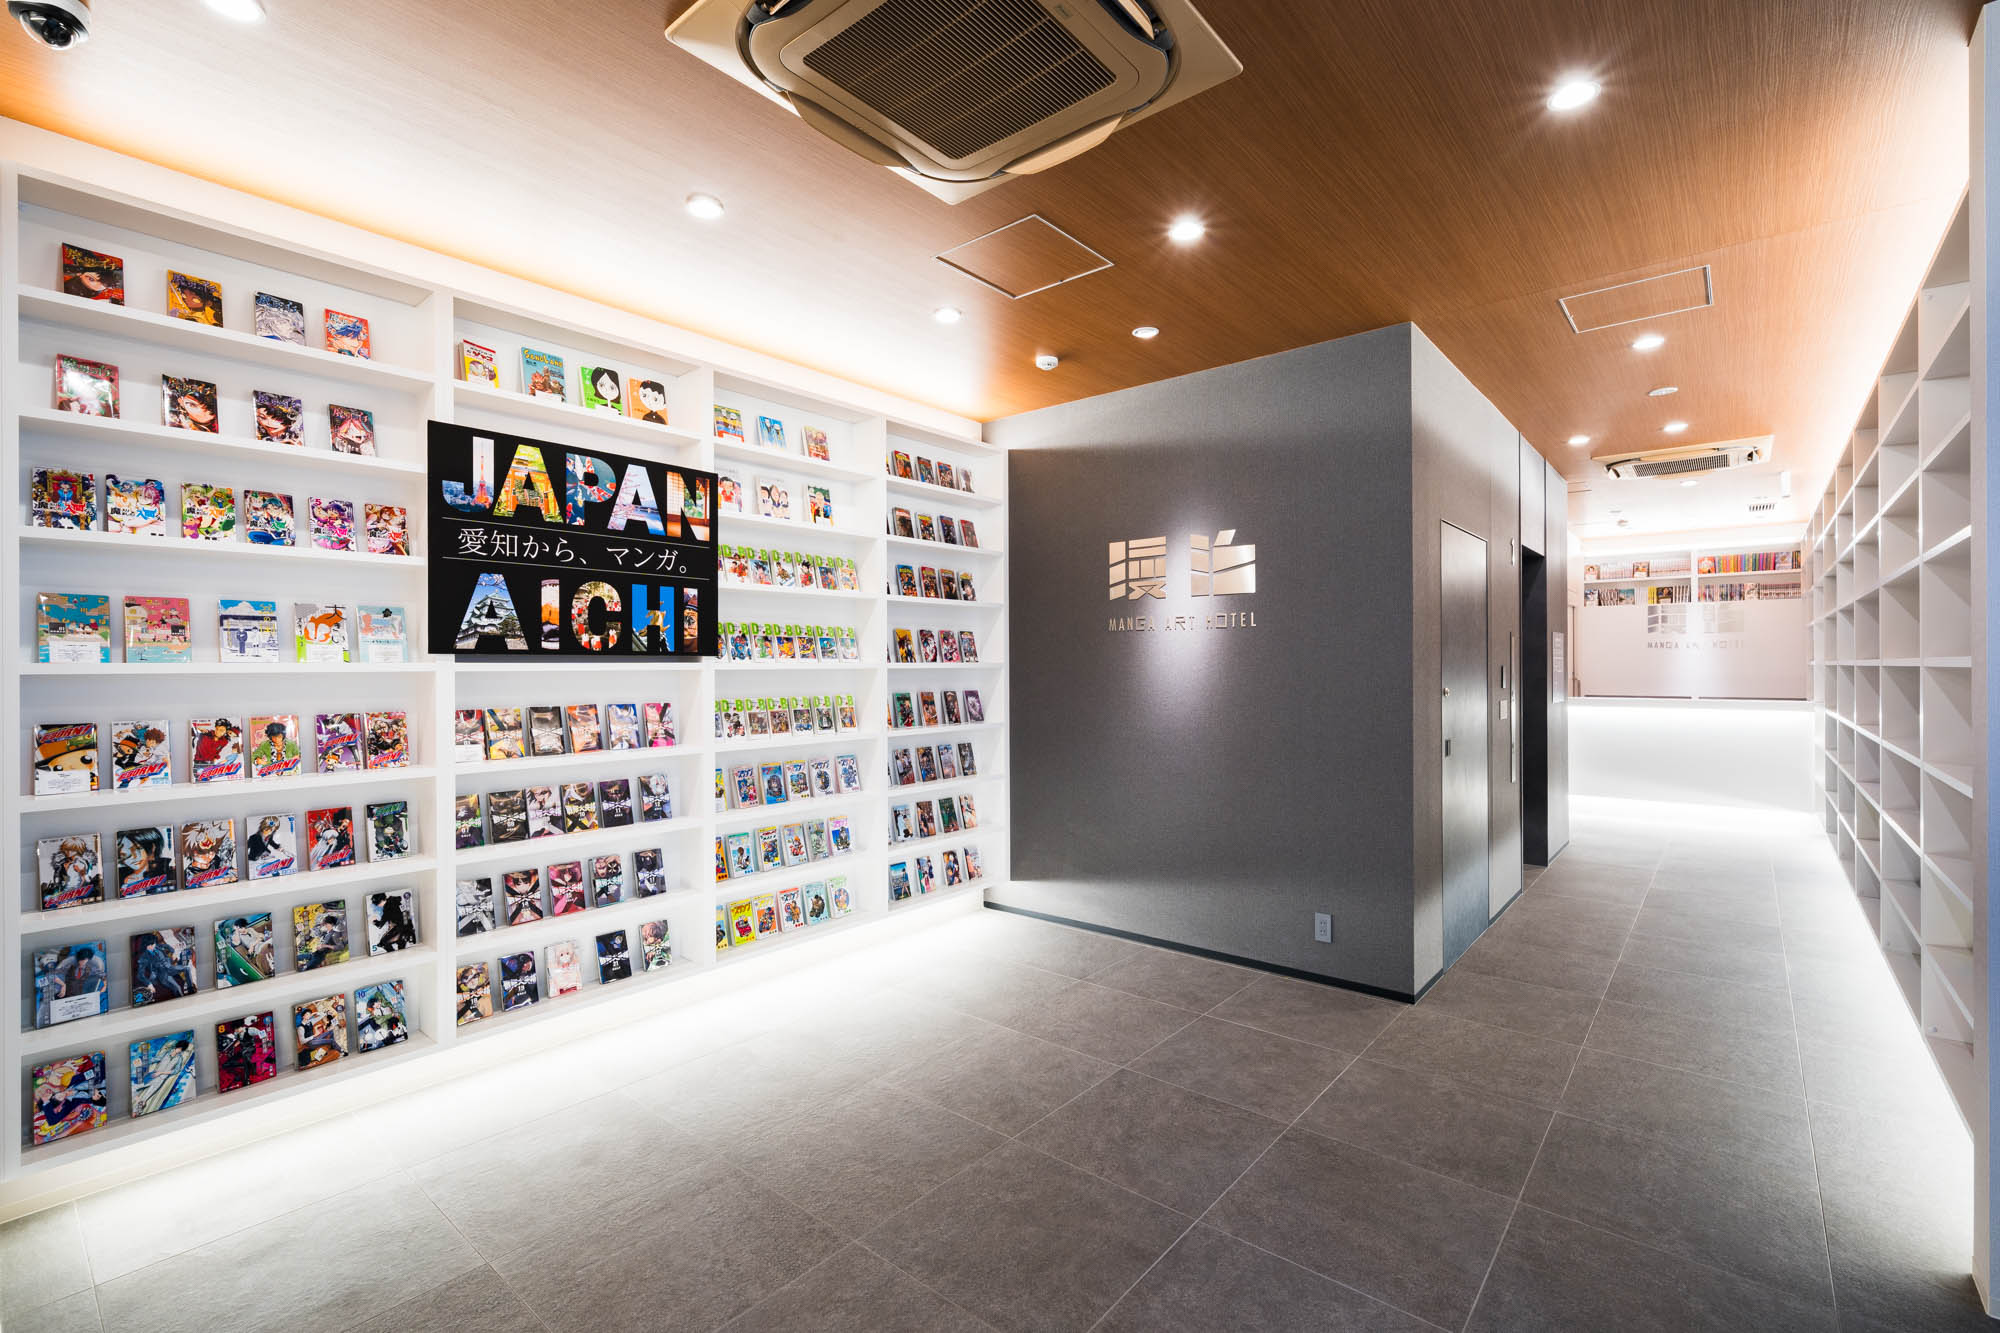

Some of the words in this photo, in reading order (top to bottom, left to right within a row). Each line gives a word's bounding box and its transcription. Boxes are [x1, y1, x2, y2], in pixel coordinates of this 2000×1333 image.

[442, 436, 710, 542] JAPAN
[457, 528, 687, 573] 愛知から、マンガ。
[453, 573, 698, 652] AICHI
[1108, 615, 1155, 632] MANGA
[1206, 612, 1257, 631] HOTEL
[135, 992, 144, 1003] 2
[218, 1023, 225, 1034] 8
